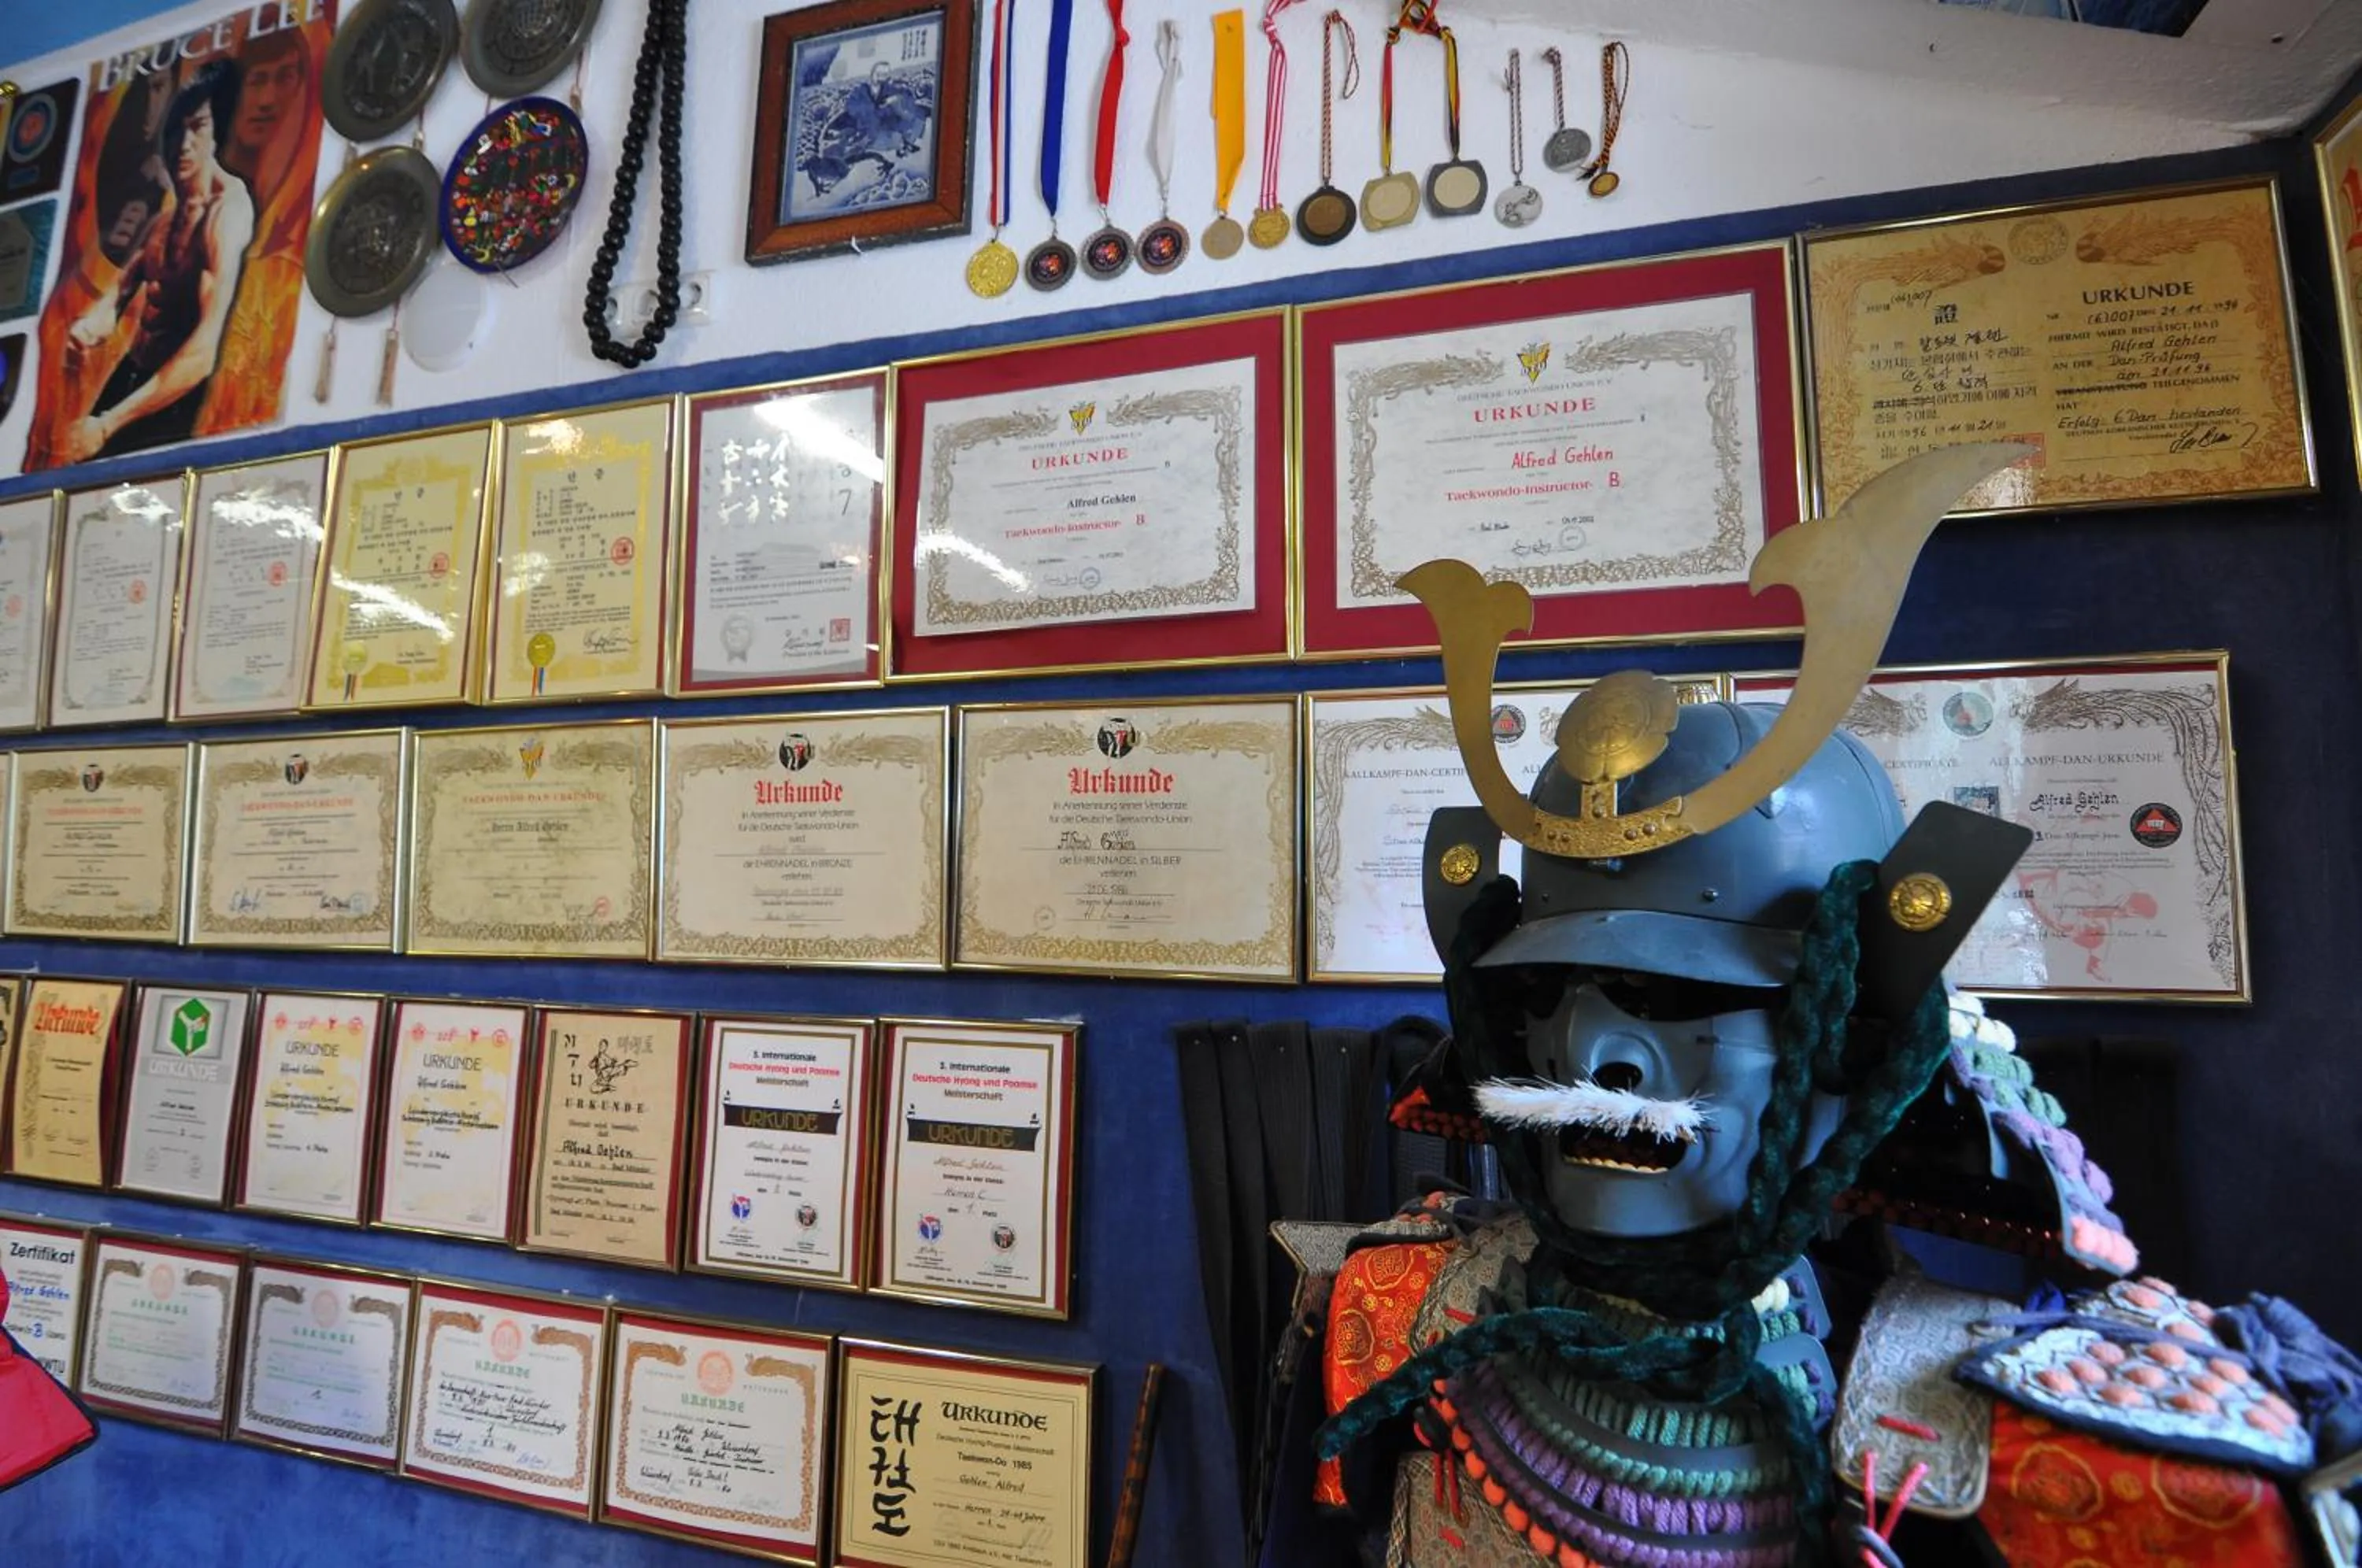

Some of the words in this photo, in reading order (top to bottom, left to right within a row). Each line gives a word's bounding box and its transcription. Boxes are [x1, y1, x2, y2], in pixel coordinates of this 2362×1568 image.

[99, 20, 234, 91] BRUCE
[2082, 281, 2195, 305] URKUNDE
[2097, 328, 2126, 338] WIRD
[2112, 338, 2154, 353] Alfred
[2164, 334, 2217, 349] Gehlen
[1474, 397, 1597, 423] URKUNDE
[1031, 447, 1130, 471] URKUNDE
[1512, 449, 1557, 469] Alfred
[1564, 444, 1614, 464] Gehlen
[1609, 471, 1620, 488] B
[1067, 496, 1099, 510] Alfred
[1135, 513, 1146, 526] B
[1068, 766, 1174, 794] Urkunde
[754, 778, 844, 805] Urkunde
[2028, 793, 2074, 813] Alfred
[423, 1053, 482, 1071] URKUNDE
[761, 1052, 817, 1062] Internationale
[729, 1062, 763, 1071] Deutsche
[792, 1065, 807, 1074] und
[949, 1062, 1011, 1074] Internationale
[913, 1073, 952, 1085] Deutsche
[983, 1078, 1001, 1087] und
[944, 1089, 1004, 1101] Meisterschaft
[742, 1107, 819, 1132] URKUNDE
[929, 1123, 1014, 1148] URKUNDE
[10, 1242, 76, 1265] Zertifikat
